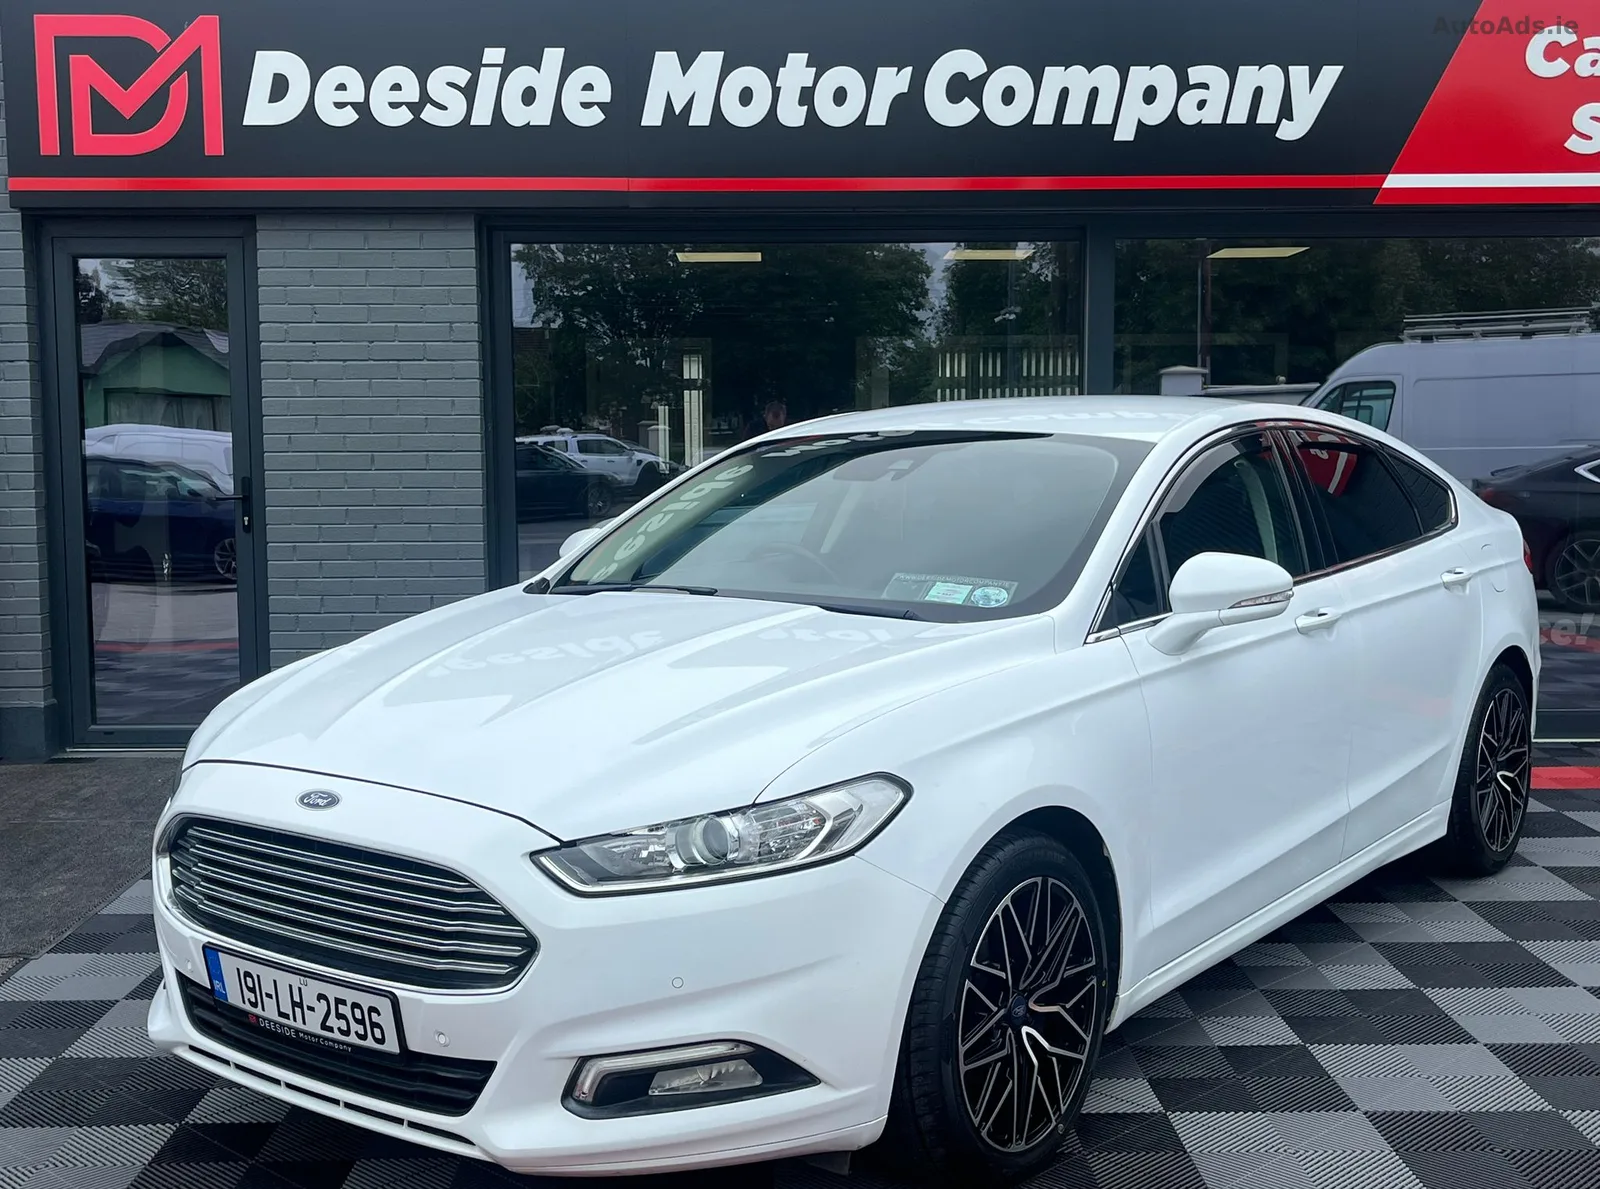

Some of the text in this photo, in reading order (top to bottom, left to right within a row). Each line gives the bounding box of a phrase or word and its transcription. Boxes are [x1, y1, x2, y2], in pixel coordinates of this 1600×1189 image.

[242, 47, 1343, 141] Deeside Motor Company
[236, 967, 387, 1046] 191-LH-2596
[258, 1017, 297, 1039] DEESIDE
[298, 1031, 319, 1043] Motor
[319, 1038, 352, 1053] Company
